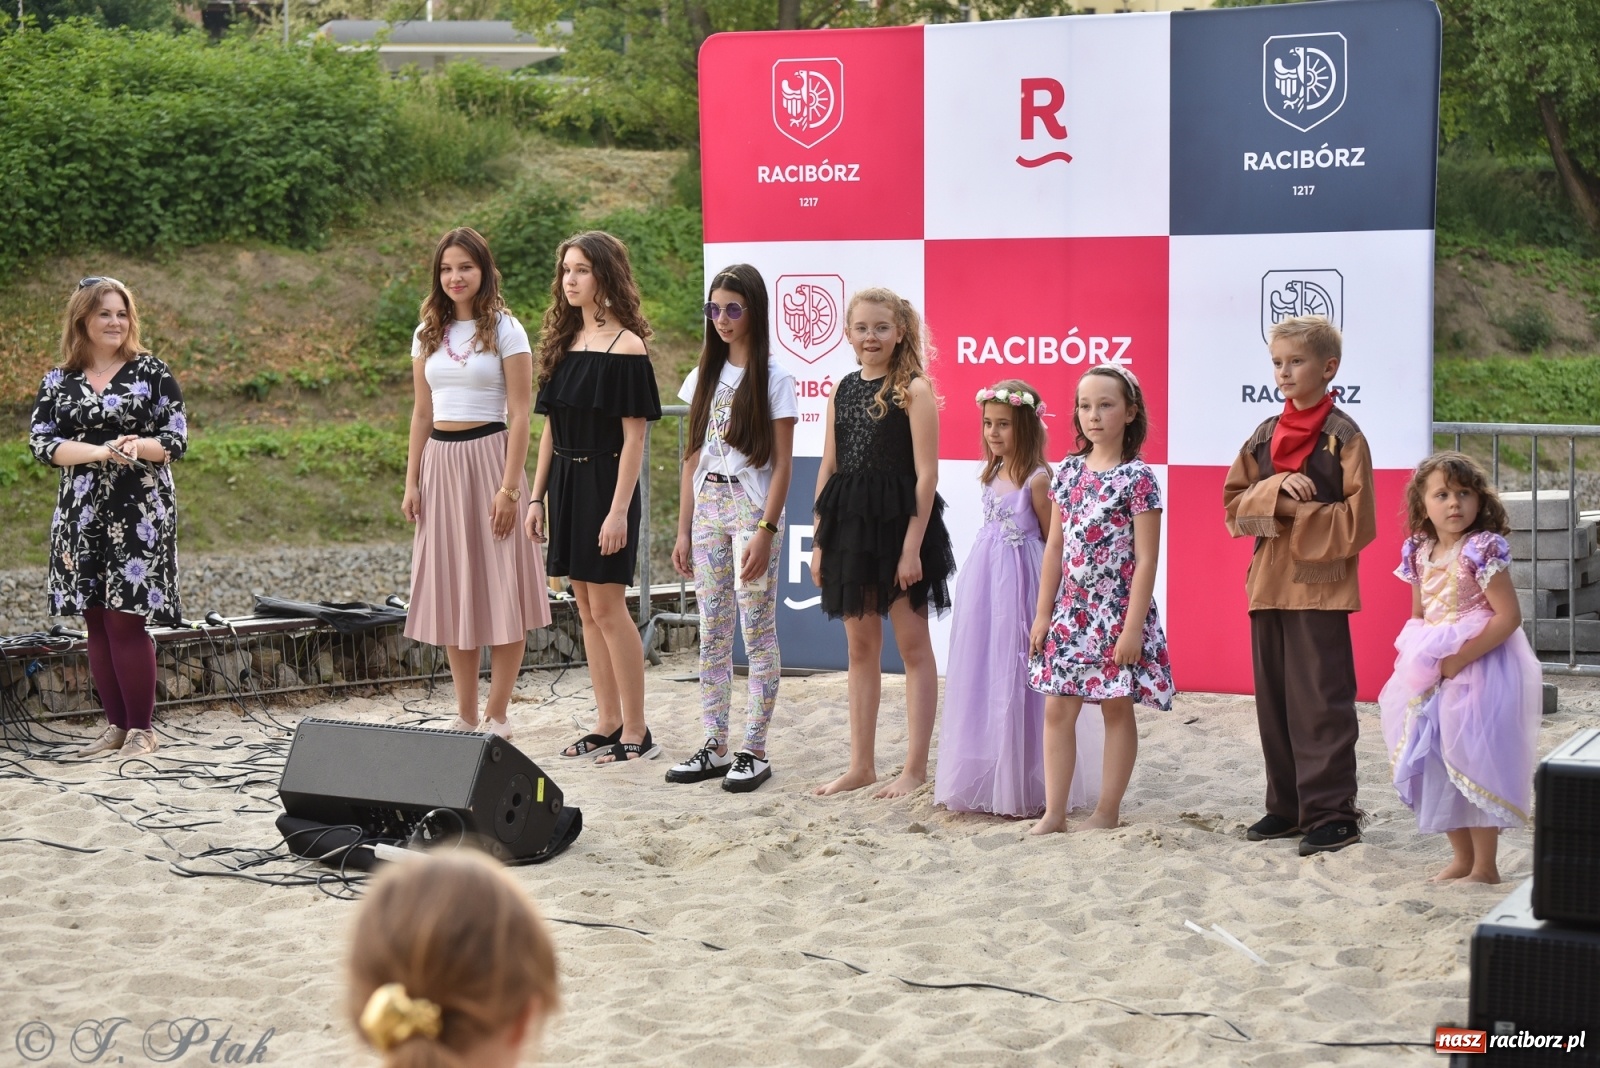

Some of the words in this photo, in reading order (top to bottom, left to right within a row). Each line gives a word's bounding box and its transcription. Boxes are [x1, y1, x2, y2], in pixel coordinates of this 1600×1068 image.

[1020, 77, 1068, 140] R
[1243, 142, 1366, 171] RACIBÓRZ
[757, 159, 861, 184] RACIBÓRZ
[798, 197, 819, 208] 1217
[1292, 184, 1316, 196] 1217
[957, 326, 1133, 365] RACIBÓRZ
[801, 413, 820, 422] 1217
